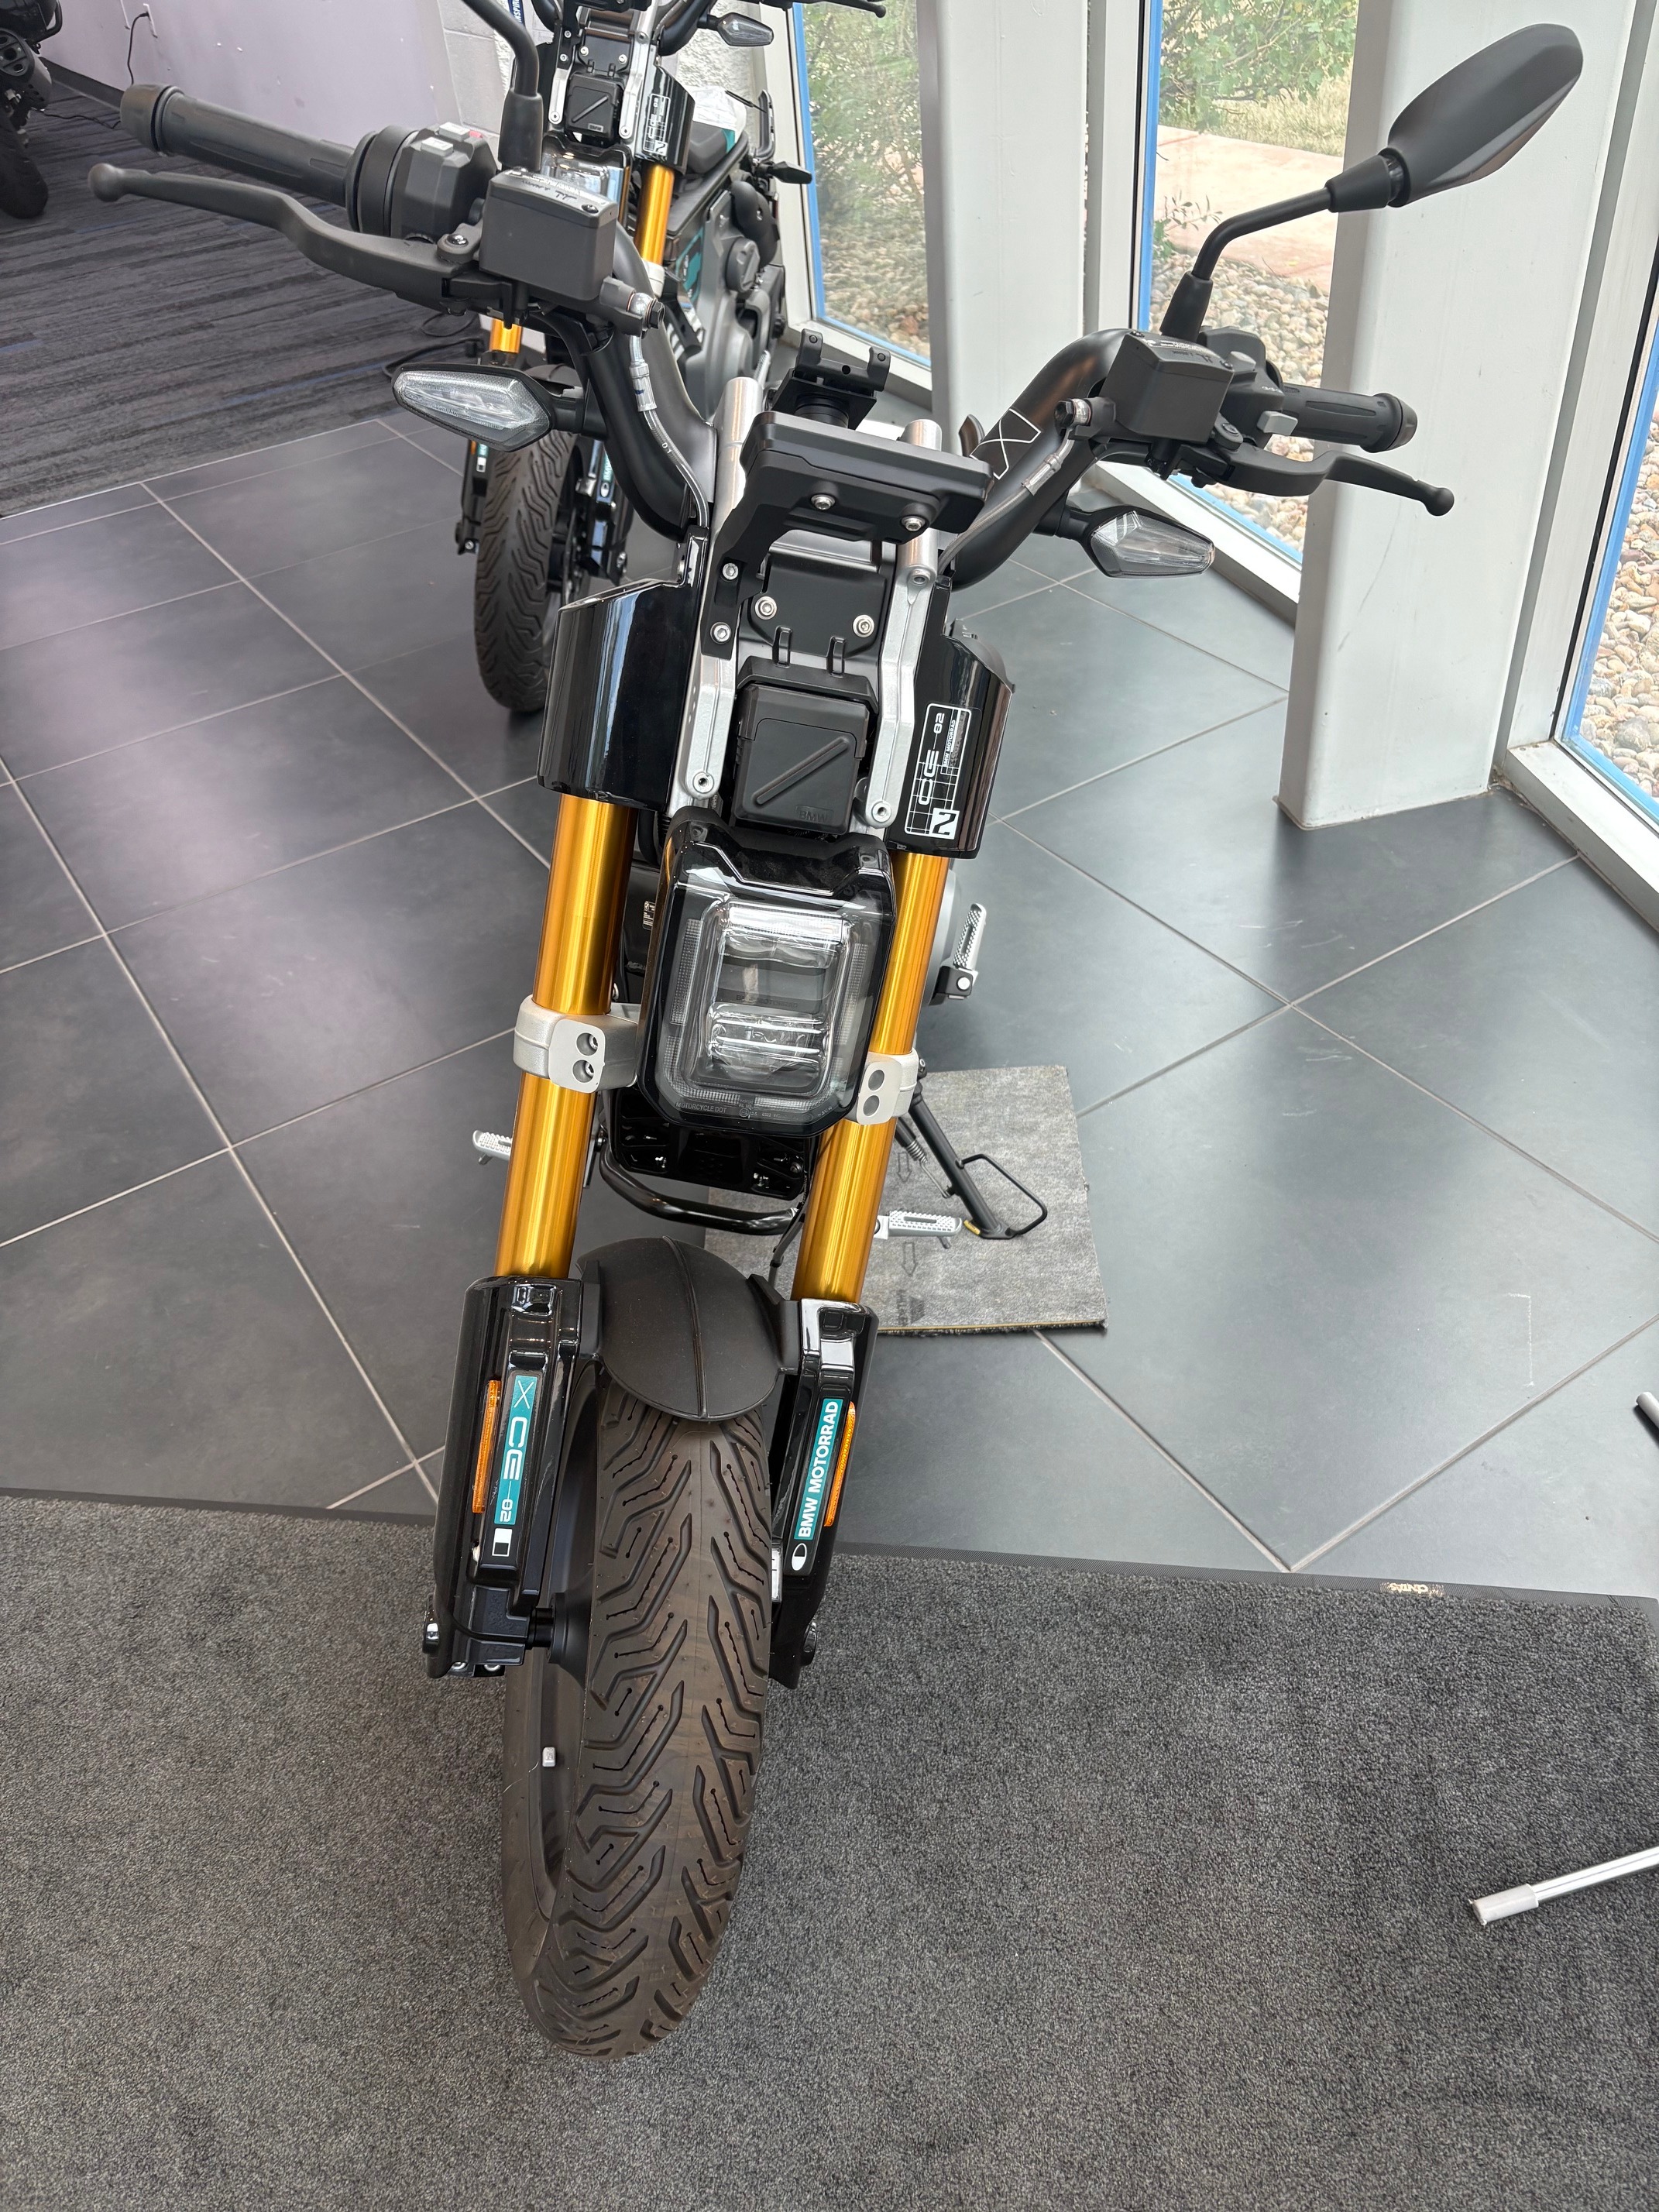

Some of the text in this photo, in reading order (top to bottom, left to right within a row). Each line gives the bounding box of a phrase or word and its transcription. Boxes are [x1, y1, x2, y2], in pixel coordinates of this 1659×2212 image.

[946, 720, 956, 753] MOTORRAD
[799, 810, 829, 823] BMW
[675, 1102, 713, 1112] MOTORCYCLE
[798, 1401, 839, 1537] BMW MOTORRAD
